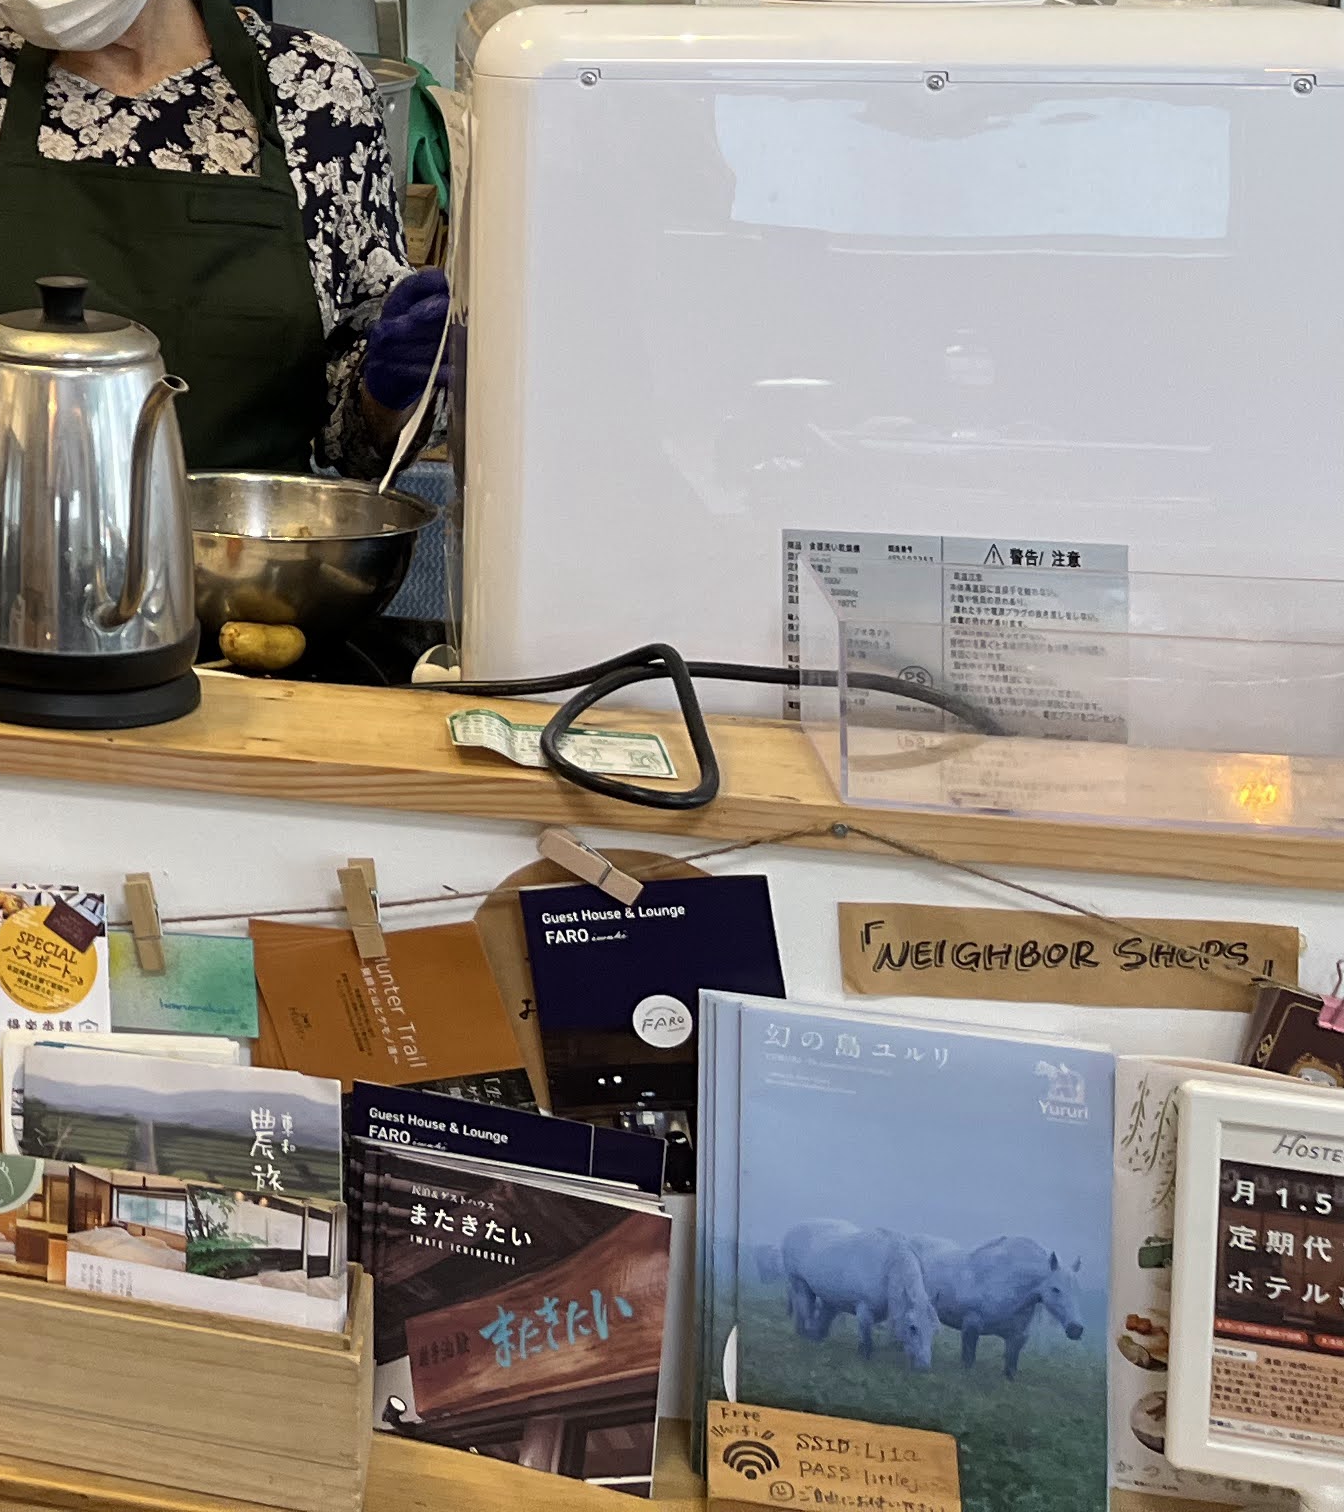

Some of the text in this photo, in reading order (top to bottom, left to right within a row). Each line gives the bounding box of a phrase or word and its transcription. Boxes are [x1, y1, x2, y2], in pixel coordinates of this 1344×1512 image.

[1010, 548, 1081, 568] 警告/ 注意
[541, 904, 686, 925] Guest House & Lounge
[16, 930, 78, 965] SPECIAL
[545, 928, 589, 945] FARO
[641, 1015, 685, 1034] FARO
[397, 1021, 429, 1069] Trail
[763, 1022, 949, 1069] 幻の島ユルリ
[1038, 1097, 1090, 1120] Yururi
[368, 1106, 510, 1145] Guest House & Lounge
[368, 1124, 411, 1144] FARO
[1272, 1133, 1344, 1164] HOSTE
[410, 1203, 533, 1247] またきたい
[410, 1234, 517, 1267] IWATE ICHINOSEKI
